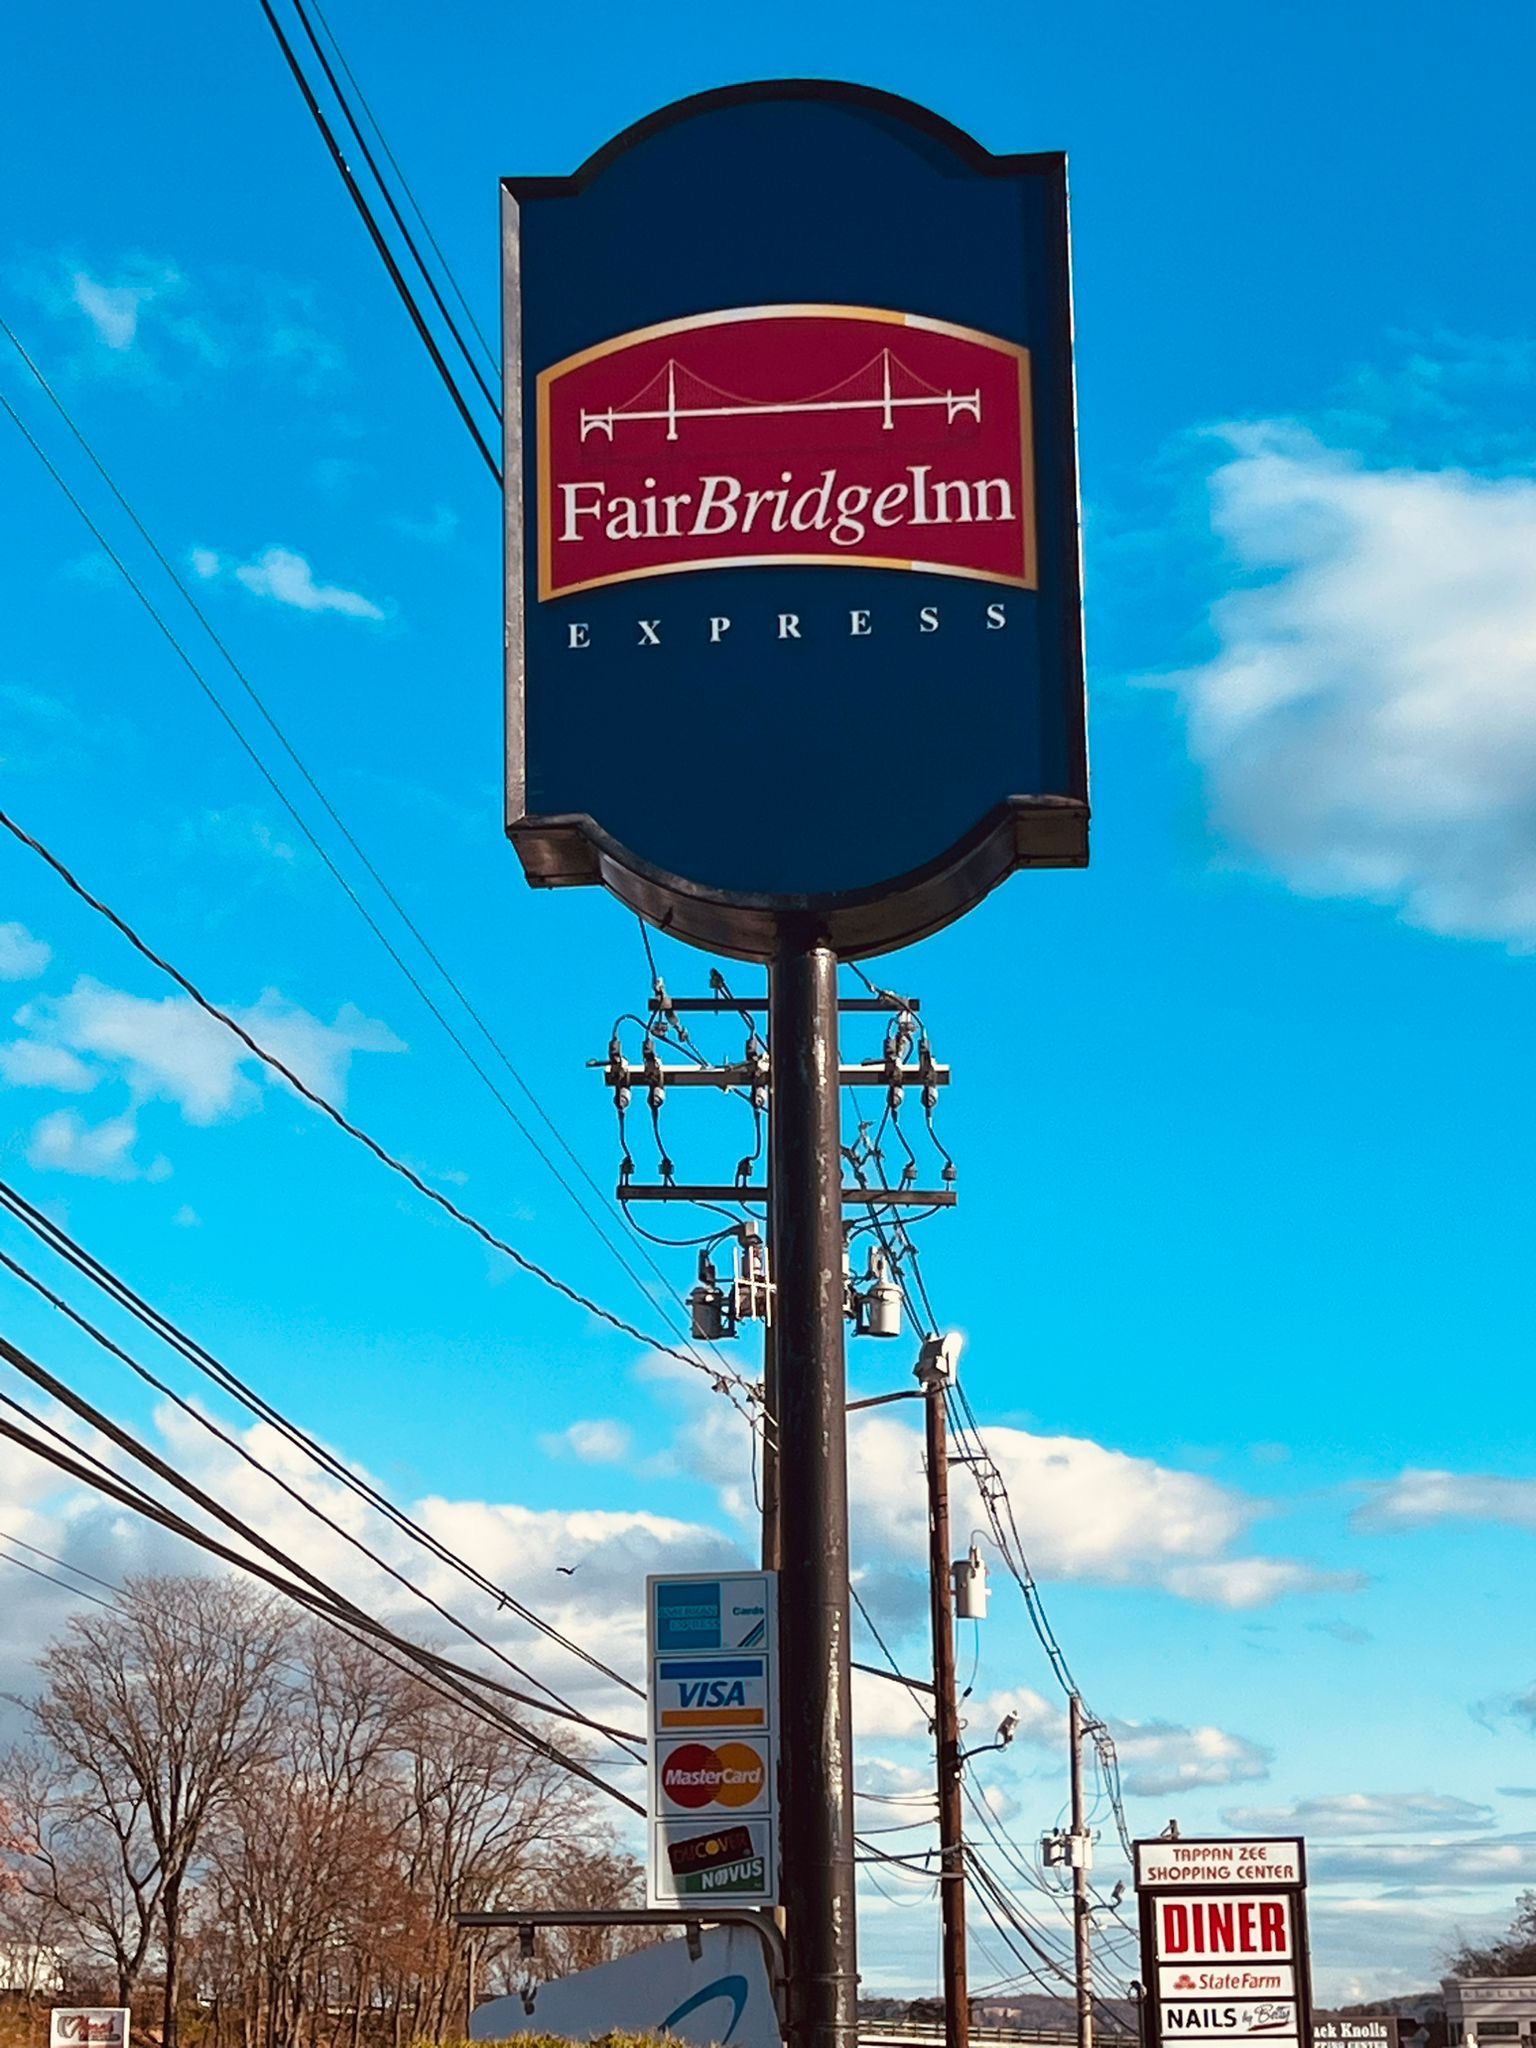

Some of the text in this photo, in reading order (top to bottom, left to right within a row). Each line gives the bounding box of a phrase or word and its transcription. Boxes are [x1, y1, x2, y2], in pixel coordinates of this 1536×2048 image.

[558, 464, 1016, 546] FairBridgeInn
[567, 603, 1007, 650] EXPRESS
[678, 1681, 746, 1708] VISA
[665, 1768, 761, 1786] MasterCard
[1173, 1847, 1267, 1862] TAPPAN ZEE
[1147, 1865, 1294, 1881] SHOPPING CENTER
[1163, 1902, 1287, 1954] DINER
[1167, 2008, 1237, 2029] NAILS
[1340, 2022, 1388, 2038] Knolls
